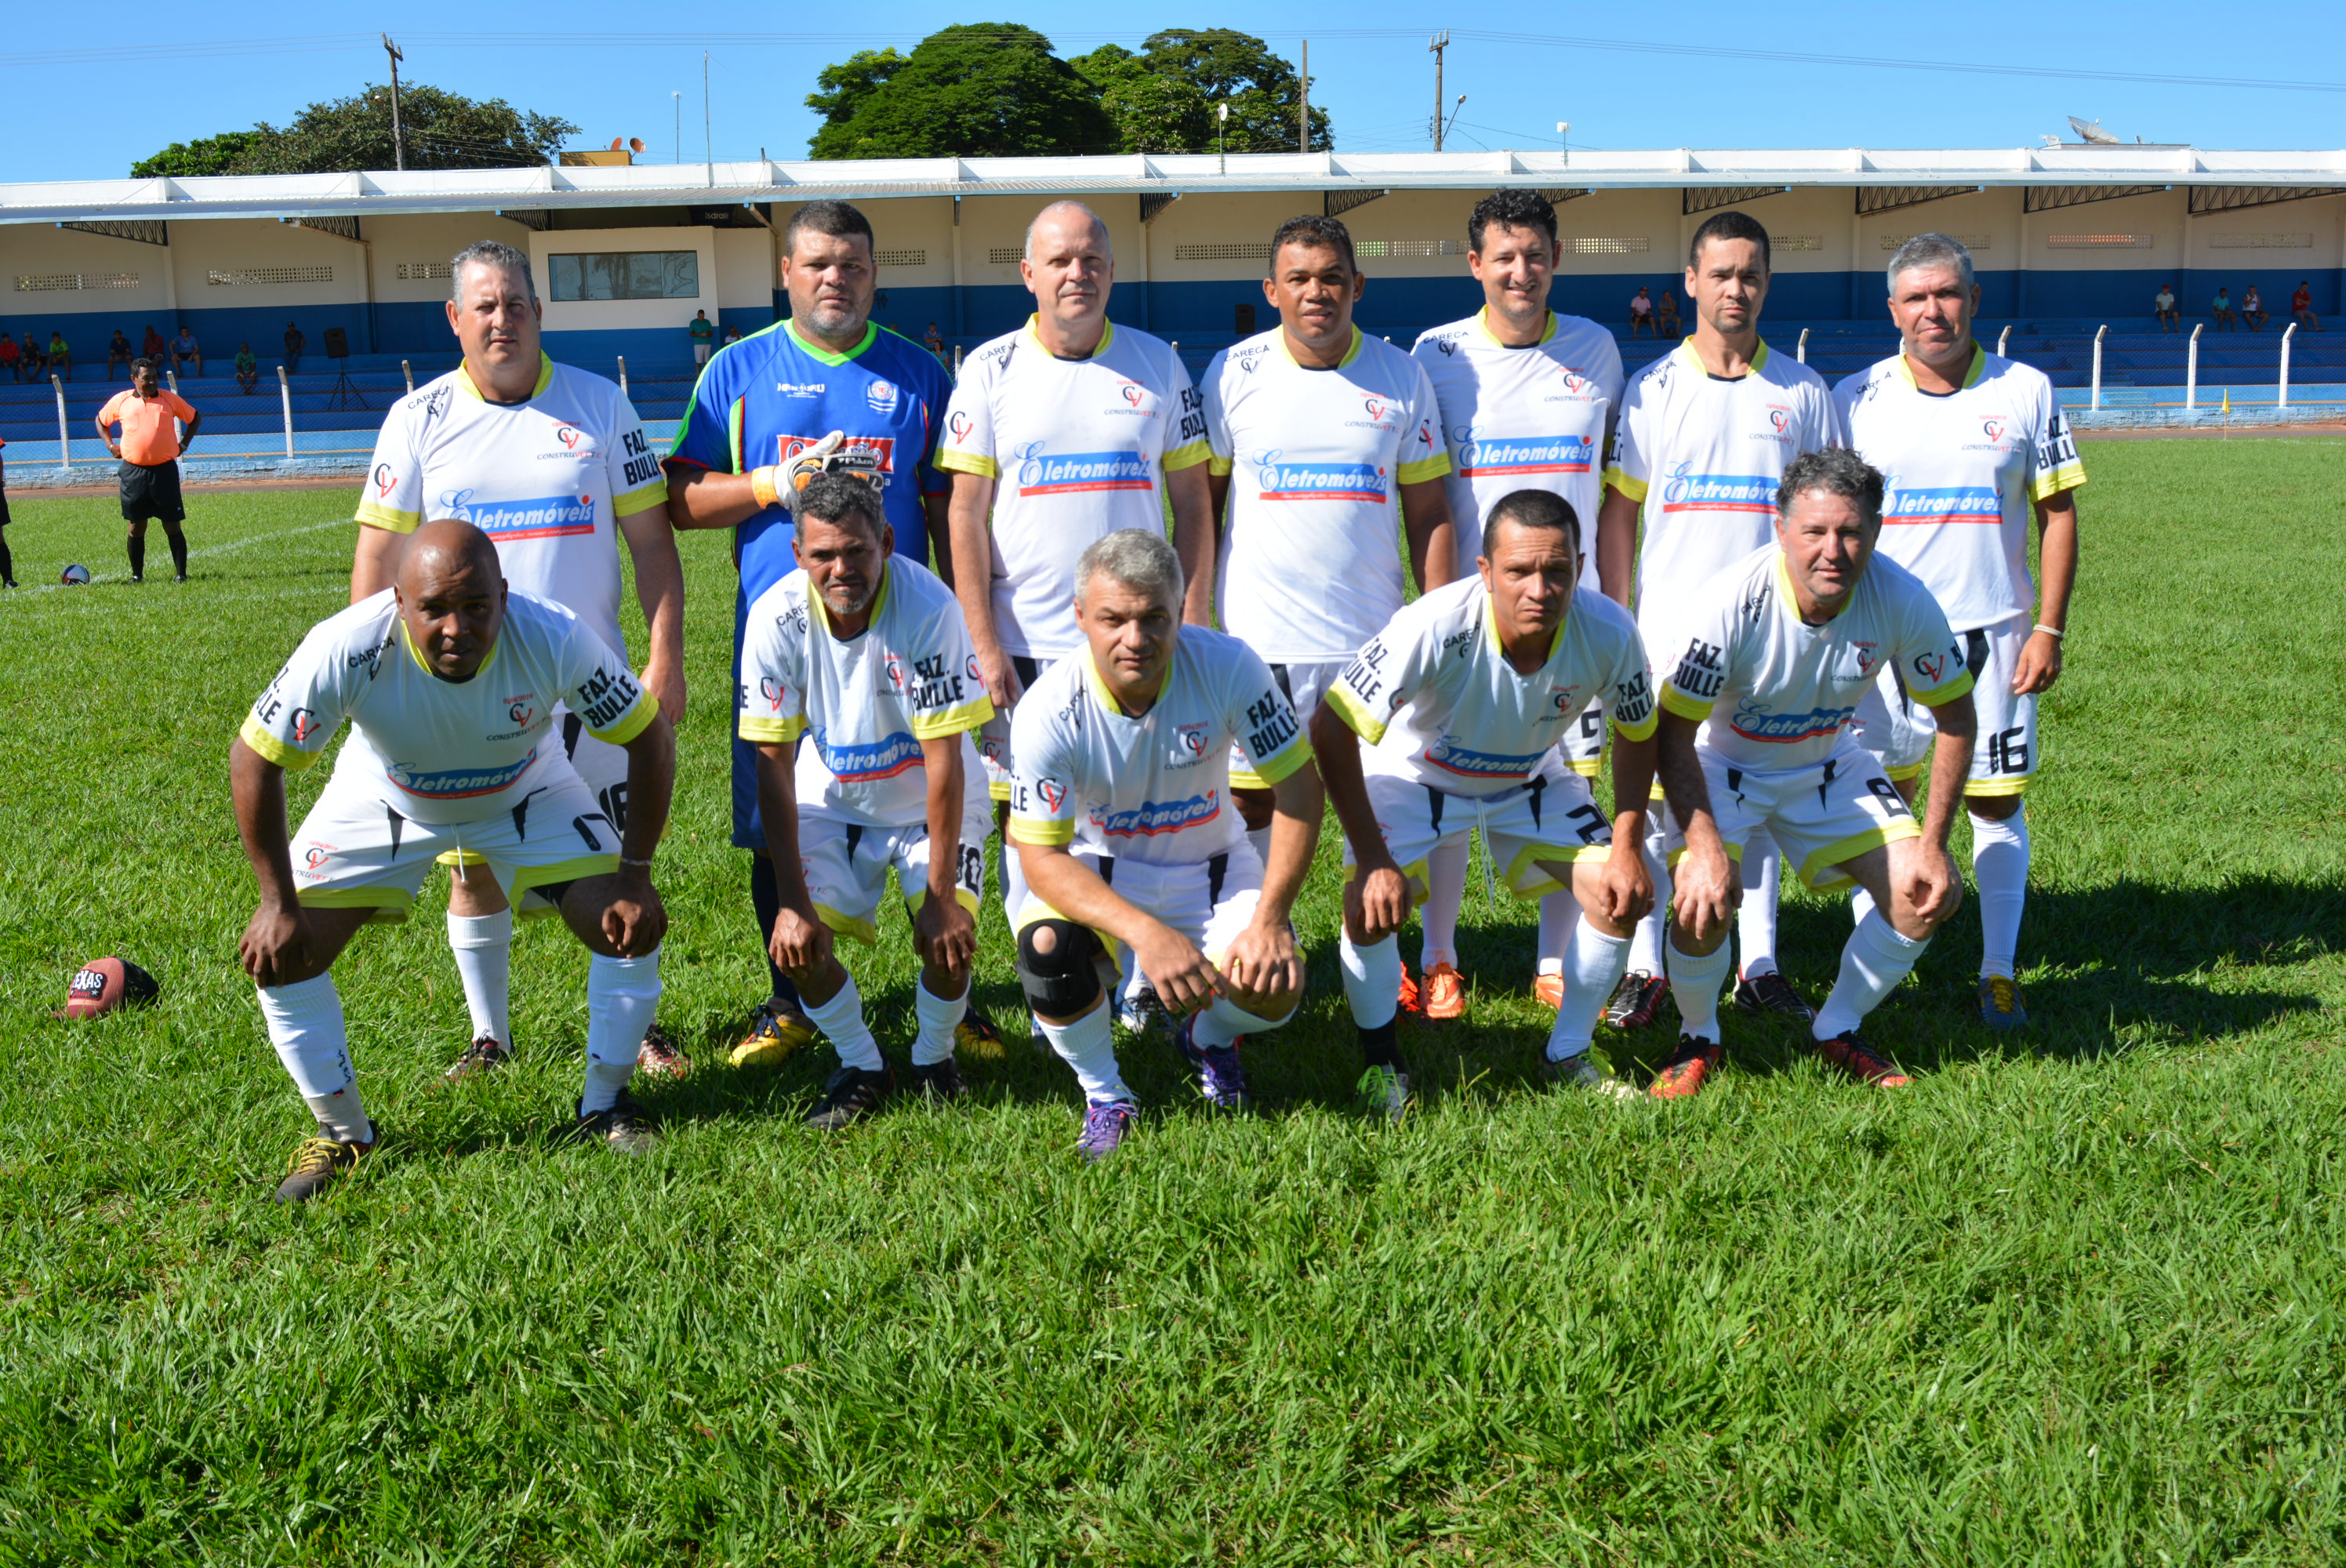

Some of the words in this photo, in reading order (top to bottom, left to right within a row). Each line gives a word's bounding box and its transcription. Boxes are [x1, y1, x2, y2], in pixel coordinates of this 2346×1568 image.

[1224, 344, 1270, 362] CARECA
[1423, 330, 1469, 345] CARECA
[622, 428, 650, 457] FAZ.
[1452, 425, 1592, 468] Eletromóveis
[2038, 439, 2079, 471] BULL
[1252, 448, 1387, 492] Eletromóveis
[1664, 459, 1778, 504] Eletromóve
[440, 488, 594, 530] Eletromóveis
[1443, 620, 1481, 649] CAREA
[1685, 637, 1723, 672] FAZ.
[1913, 652, 1945, 684] CV
[576, 666, 616, 705] FAZ.
[912, 674, 964, 711] BULLE
[1344, 657, 1382, 704] ULLE
[1673, 660, 1725, 698] BULLE
[509, 702, 533, 728] CV
[583, 674, 639, 728] BULLE
[1246, 688, 1281, 729] FAZ.
[1615, 691, 1653, 722] BULL
[290, 707, 321, 742] CV
[1248, 706, 1299, 759] BULLE
[1186, 731, 1209, 757] CV
[1988, 725, 2029, 775] 16
[1036, 777, 1067, 815] CV
